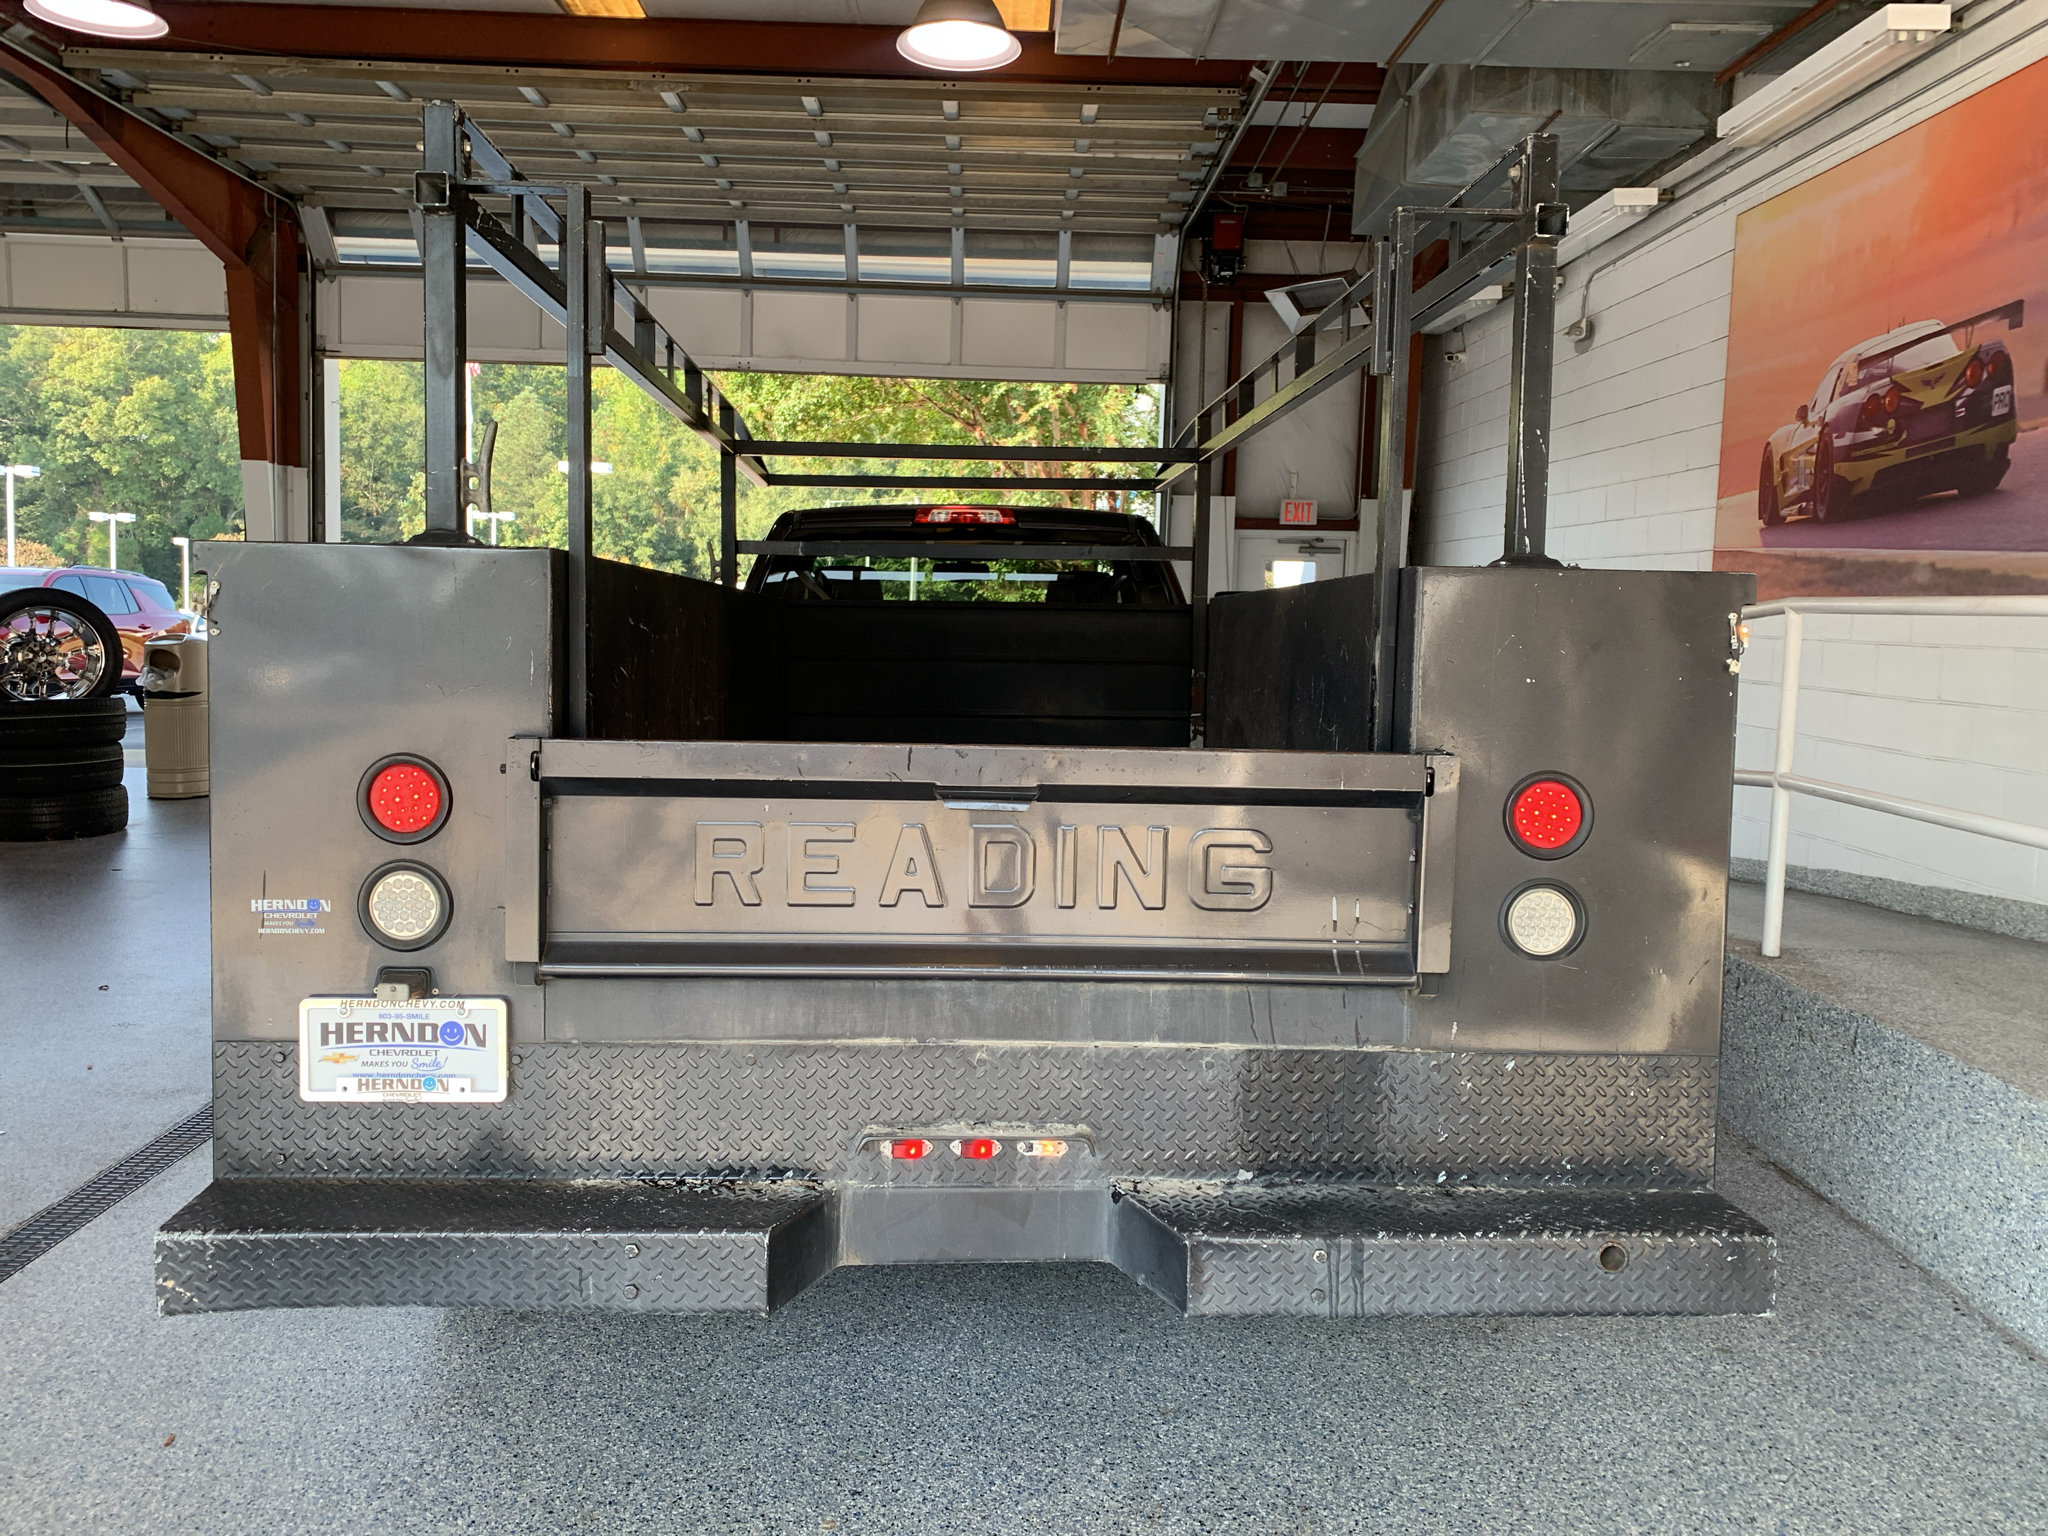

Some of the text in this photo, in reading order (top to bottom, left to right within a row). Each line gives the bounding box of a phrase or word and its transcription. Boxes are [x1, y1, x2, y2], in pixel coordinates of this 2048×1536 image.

[1284, 501, 1313, 522] EXIT
[694, 820, 1275, 911] READING
[250, 898, 331, 913] HERNDON
[340, 1000, 465, 1010] HERNDONCHEVY.COM
[320, 1020, 487, 1048] HERNDON
[369, 1049, 440, 1057] CHEVROLET
[361, 1056, 449, 1072] MAKES YOU Smile!
[357, 1076, 449, 1092] HERNDON
